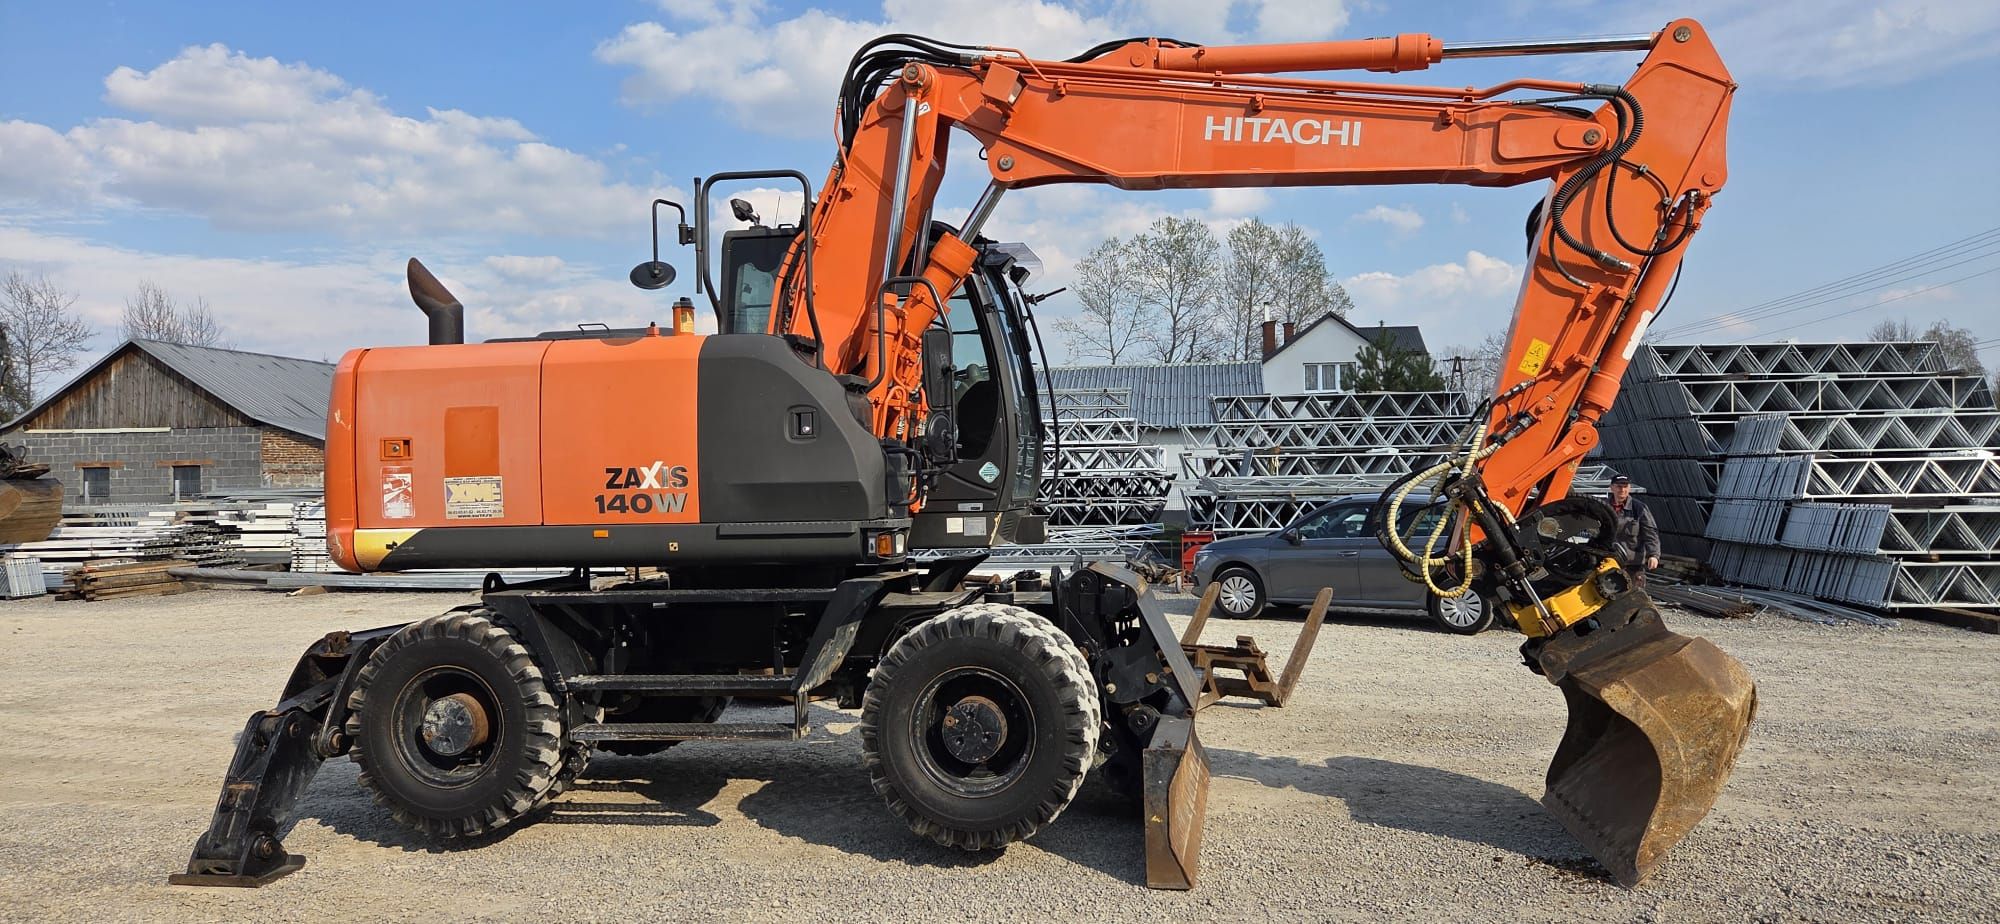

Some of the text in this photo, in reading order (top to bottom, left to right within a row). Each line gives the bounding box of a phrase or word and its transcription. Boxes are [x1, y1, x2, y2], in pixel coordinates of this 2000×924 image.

[1204, 115, 1362, 147] HITACHI
[605, 461, 689, 489] ZAXIS
[594, 492, 689, 514] 140W
